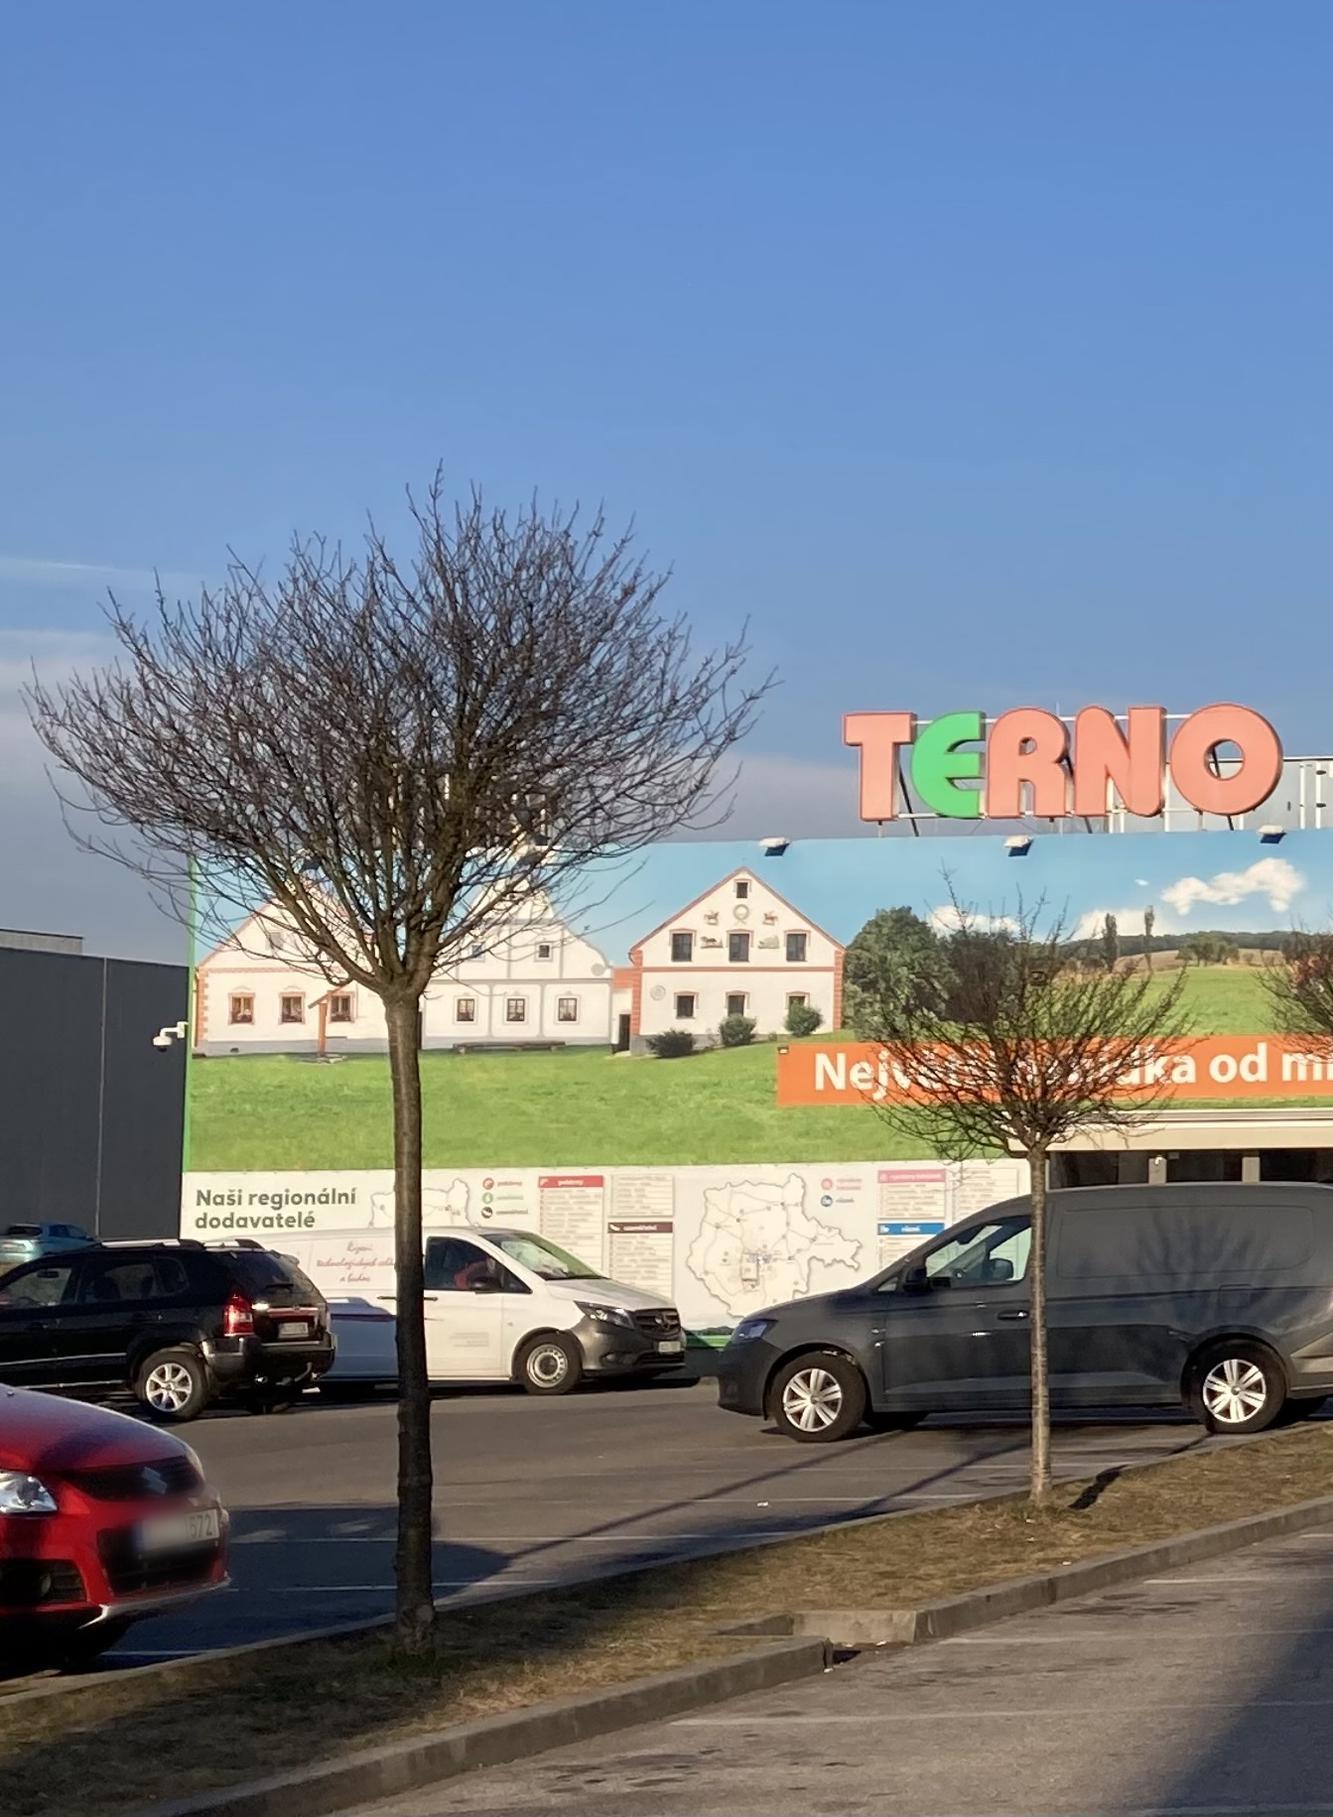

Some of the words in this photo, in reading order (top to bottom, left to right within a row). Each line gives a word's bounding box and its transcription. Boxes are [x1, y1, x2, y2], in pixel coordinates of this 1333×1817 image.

[842, 702, 1284, 822] TERNO
[1209, 1041, 1268, 1083] od
[195, 1187, 243, 1207] Naši
[248, 1187, 357, 1211] regionální
[195, 1211, 316, 1230] dodavatelé
